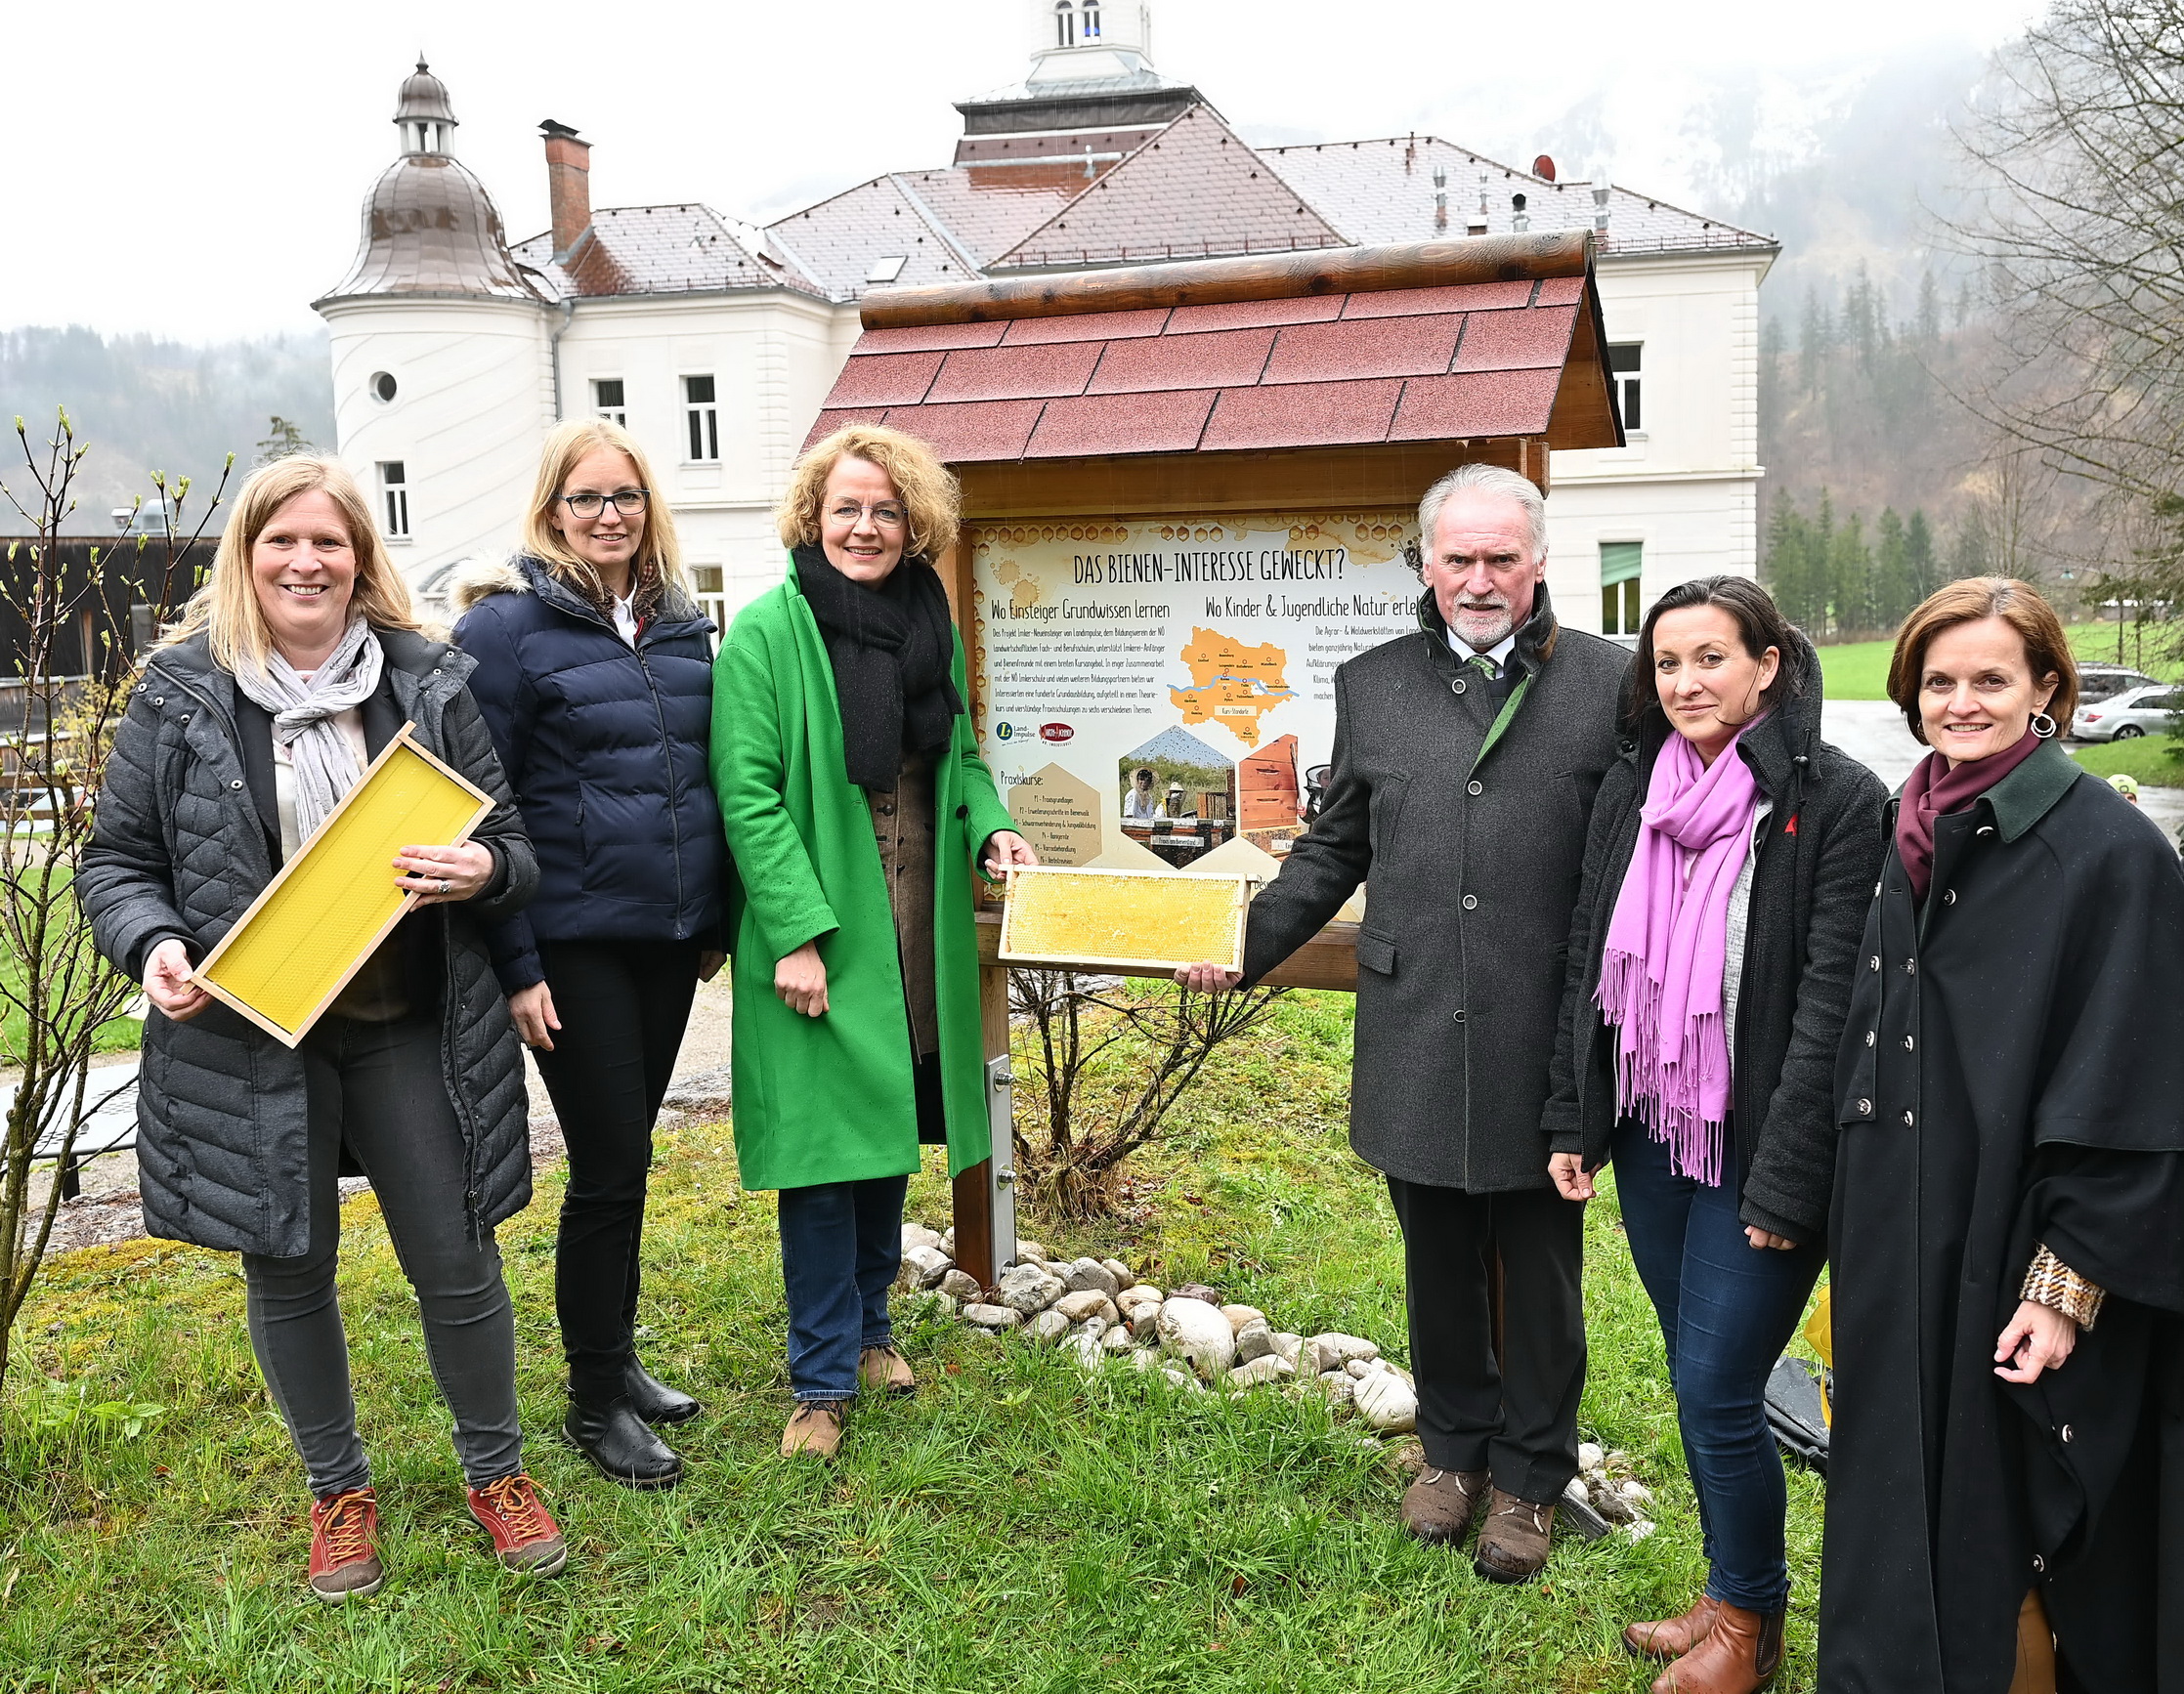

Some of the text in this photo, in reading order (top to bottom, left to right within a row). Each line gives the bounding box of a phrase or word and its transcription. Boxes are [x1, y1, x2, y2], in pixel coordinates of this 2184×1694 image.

[1074, 548, 1345, 584] DAS BIENEN-INTERESSE GEWECKT?
[991, 599, 1006, 619] Wo
[1009, 599, 1059, 623] Einsteiger
[1062, 598, 1132, 619] Grundwissen
[1206, 596, 1221, 617] Wo
[1225, 596, 1262, 617] Kinder
[1265, 594, 1277, 616] &
[1281, 595, 1349, 622] Jugendliche
[1353, 594, 1389, 616] Natur
[1002, 628, 1016, 639] Projekt
[1017, 627, 1062, 639] Imker-Neueinsteiger
[1073, 626, 1102, 638] Landimpulse,
[1103, 627, 1114, 636] dem
[1114, 626, 1148, 638] Bildungsverein
[1157, 625, 1165, 636] NÖ
[1324, 626, 1343, 637] Agrar-
[1344, 625, 1349, 635] &
[1350, 625, 1393, 635] Waldwerkstätten
[1039, 643, 1052, 653] Fach-
[1063, 643, 1095, 653] Berufsschulen,
[1095, 643, 1122, 652] unterstützt
[1123, 643, 1165, 654] Imkerei-Anfänger
[1308, 643, 1324, 652] bieten
[1325, 643, 1352, 654] ganzjährig
[994, 658, 1003, 667] und
[1003, 658, 1034, 667] Bienenfreunde
[1044, 658, 1057, 667] einem
[1058, 658, 1074, 667] breiten
[1105, 657, 1111, 666] In
[1111, 659, 1124, 669] enger
[1125, 657, 1165, 667] Zusammenarbeit
[1010, 672, 1018, 682] NÖ
[1018, 673, 1046, 682] Imkerschule
[1047, 673, 1055, 682] und
[1056, 673, 1069, 682] vielen
[1070, 673, 1090, 682] weiteren
[1091, 673, 1131, 685] Bildungspartnern
[1131, 673, 1145, 682] bieten
[1312, 674, 1330, 684] Klima,
[995, 689, 1025, 698] Interessierten
[1025, 689, 1034, 698] eine
[1035, 689, 1055, 698] fundierte
[1055, 689, 1095, 699] Grundausbildung,
[1096, 689, 1119, 700] aufgeteilt
[1138, 689, 1158, 698] Theorie-
[995, 704, 1005, 713] kurs
[1006, 704, 1014, 713] und
[1042, 704, 1081, 714] Praxisschulungen
[1088, 704, 1100, 713] sechs
[1100, 704, 1132, 713] verschiedenen
[1133, 704, 1152, 713] Themen.
[1001, 771, 1044, 785] Praxiskurse:
[1042, 795, 1074, 805] Praxisgrundlagen
[1043, 844, 1076, 854] Varroabehandlung
